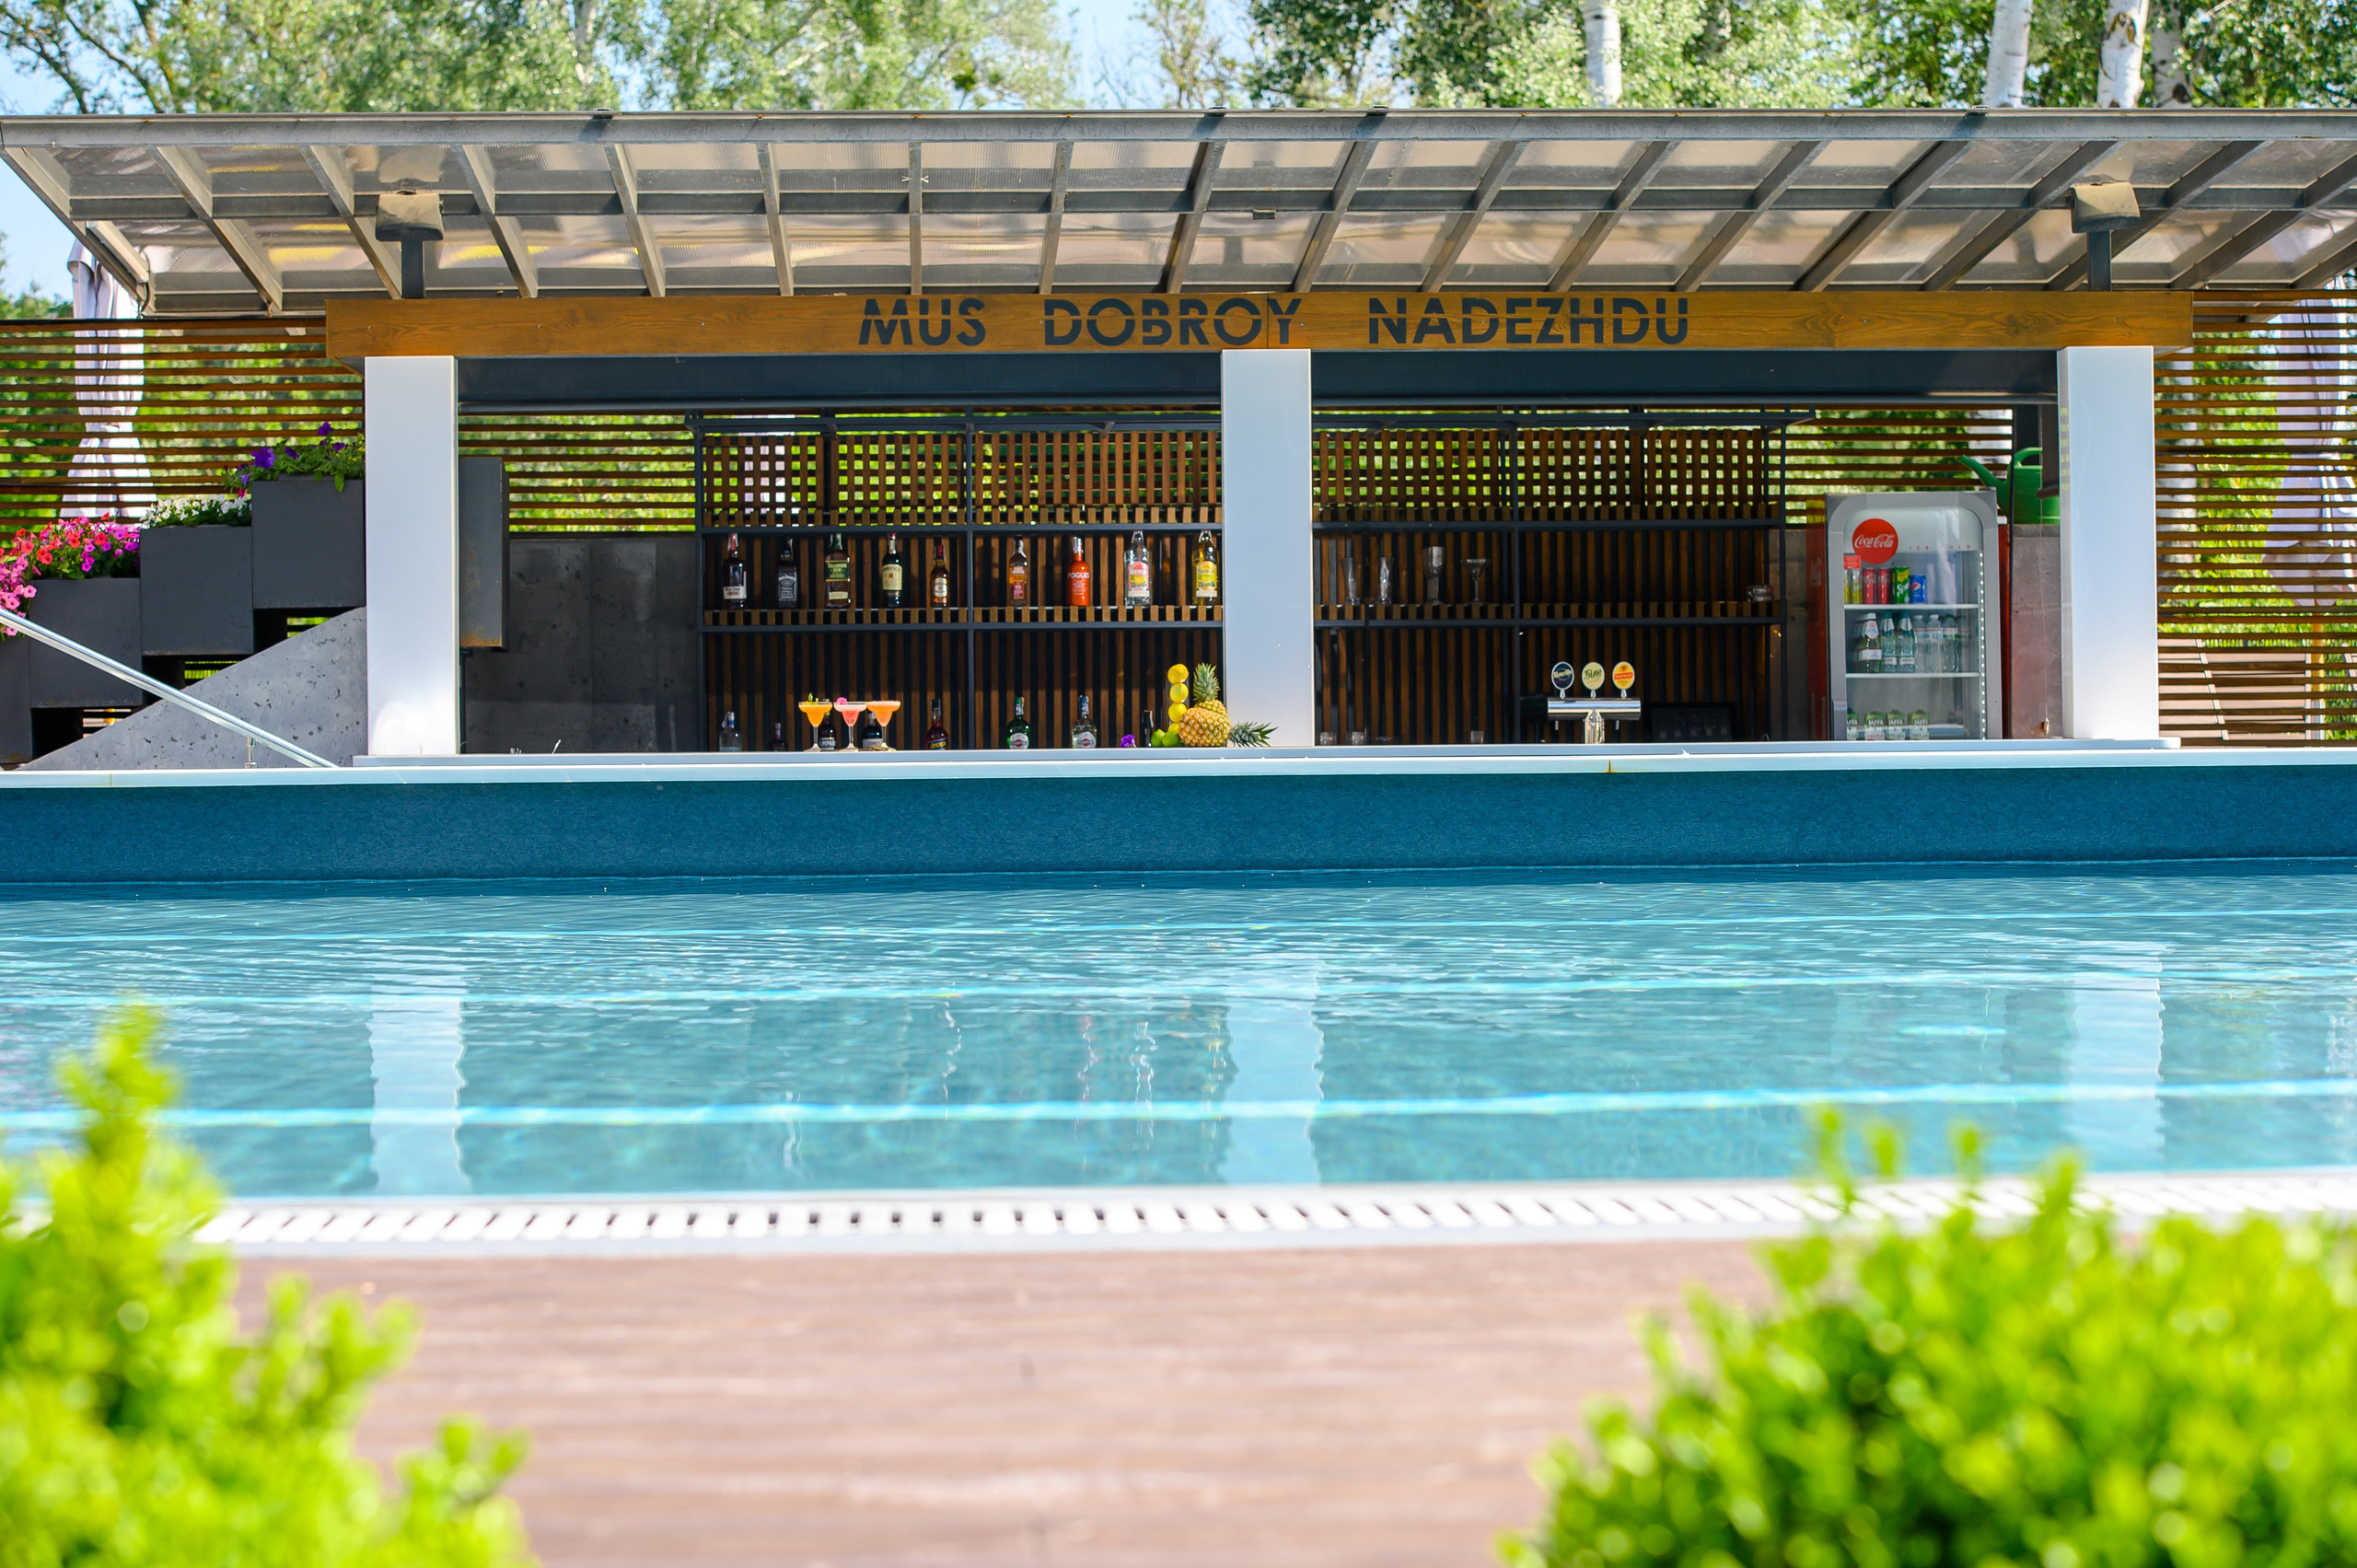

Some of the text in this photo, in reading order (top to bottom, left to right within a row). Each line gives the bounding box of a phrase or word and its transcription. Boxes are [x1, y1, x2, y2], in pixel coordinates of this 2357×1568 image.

[858, 297, 1688, 346] MUS DOBROY NADEZHDU
[1854, 533, 1895, 549] Coca-Cola
